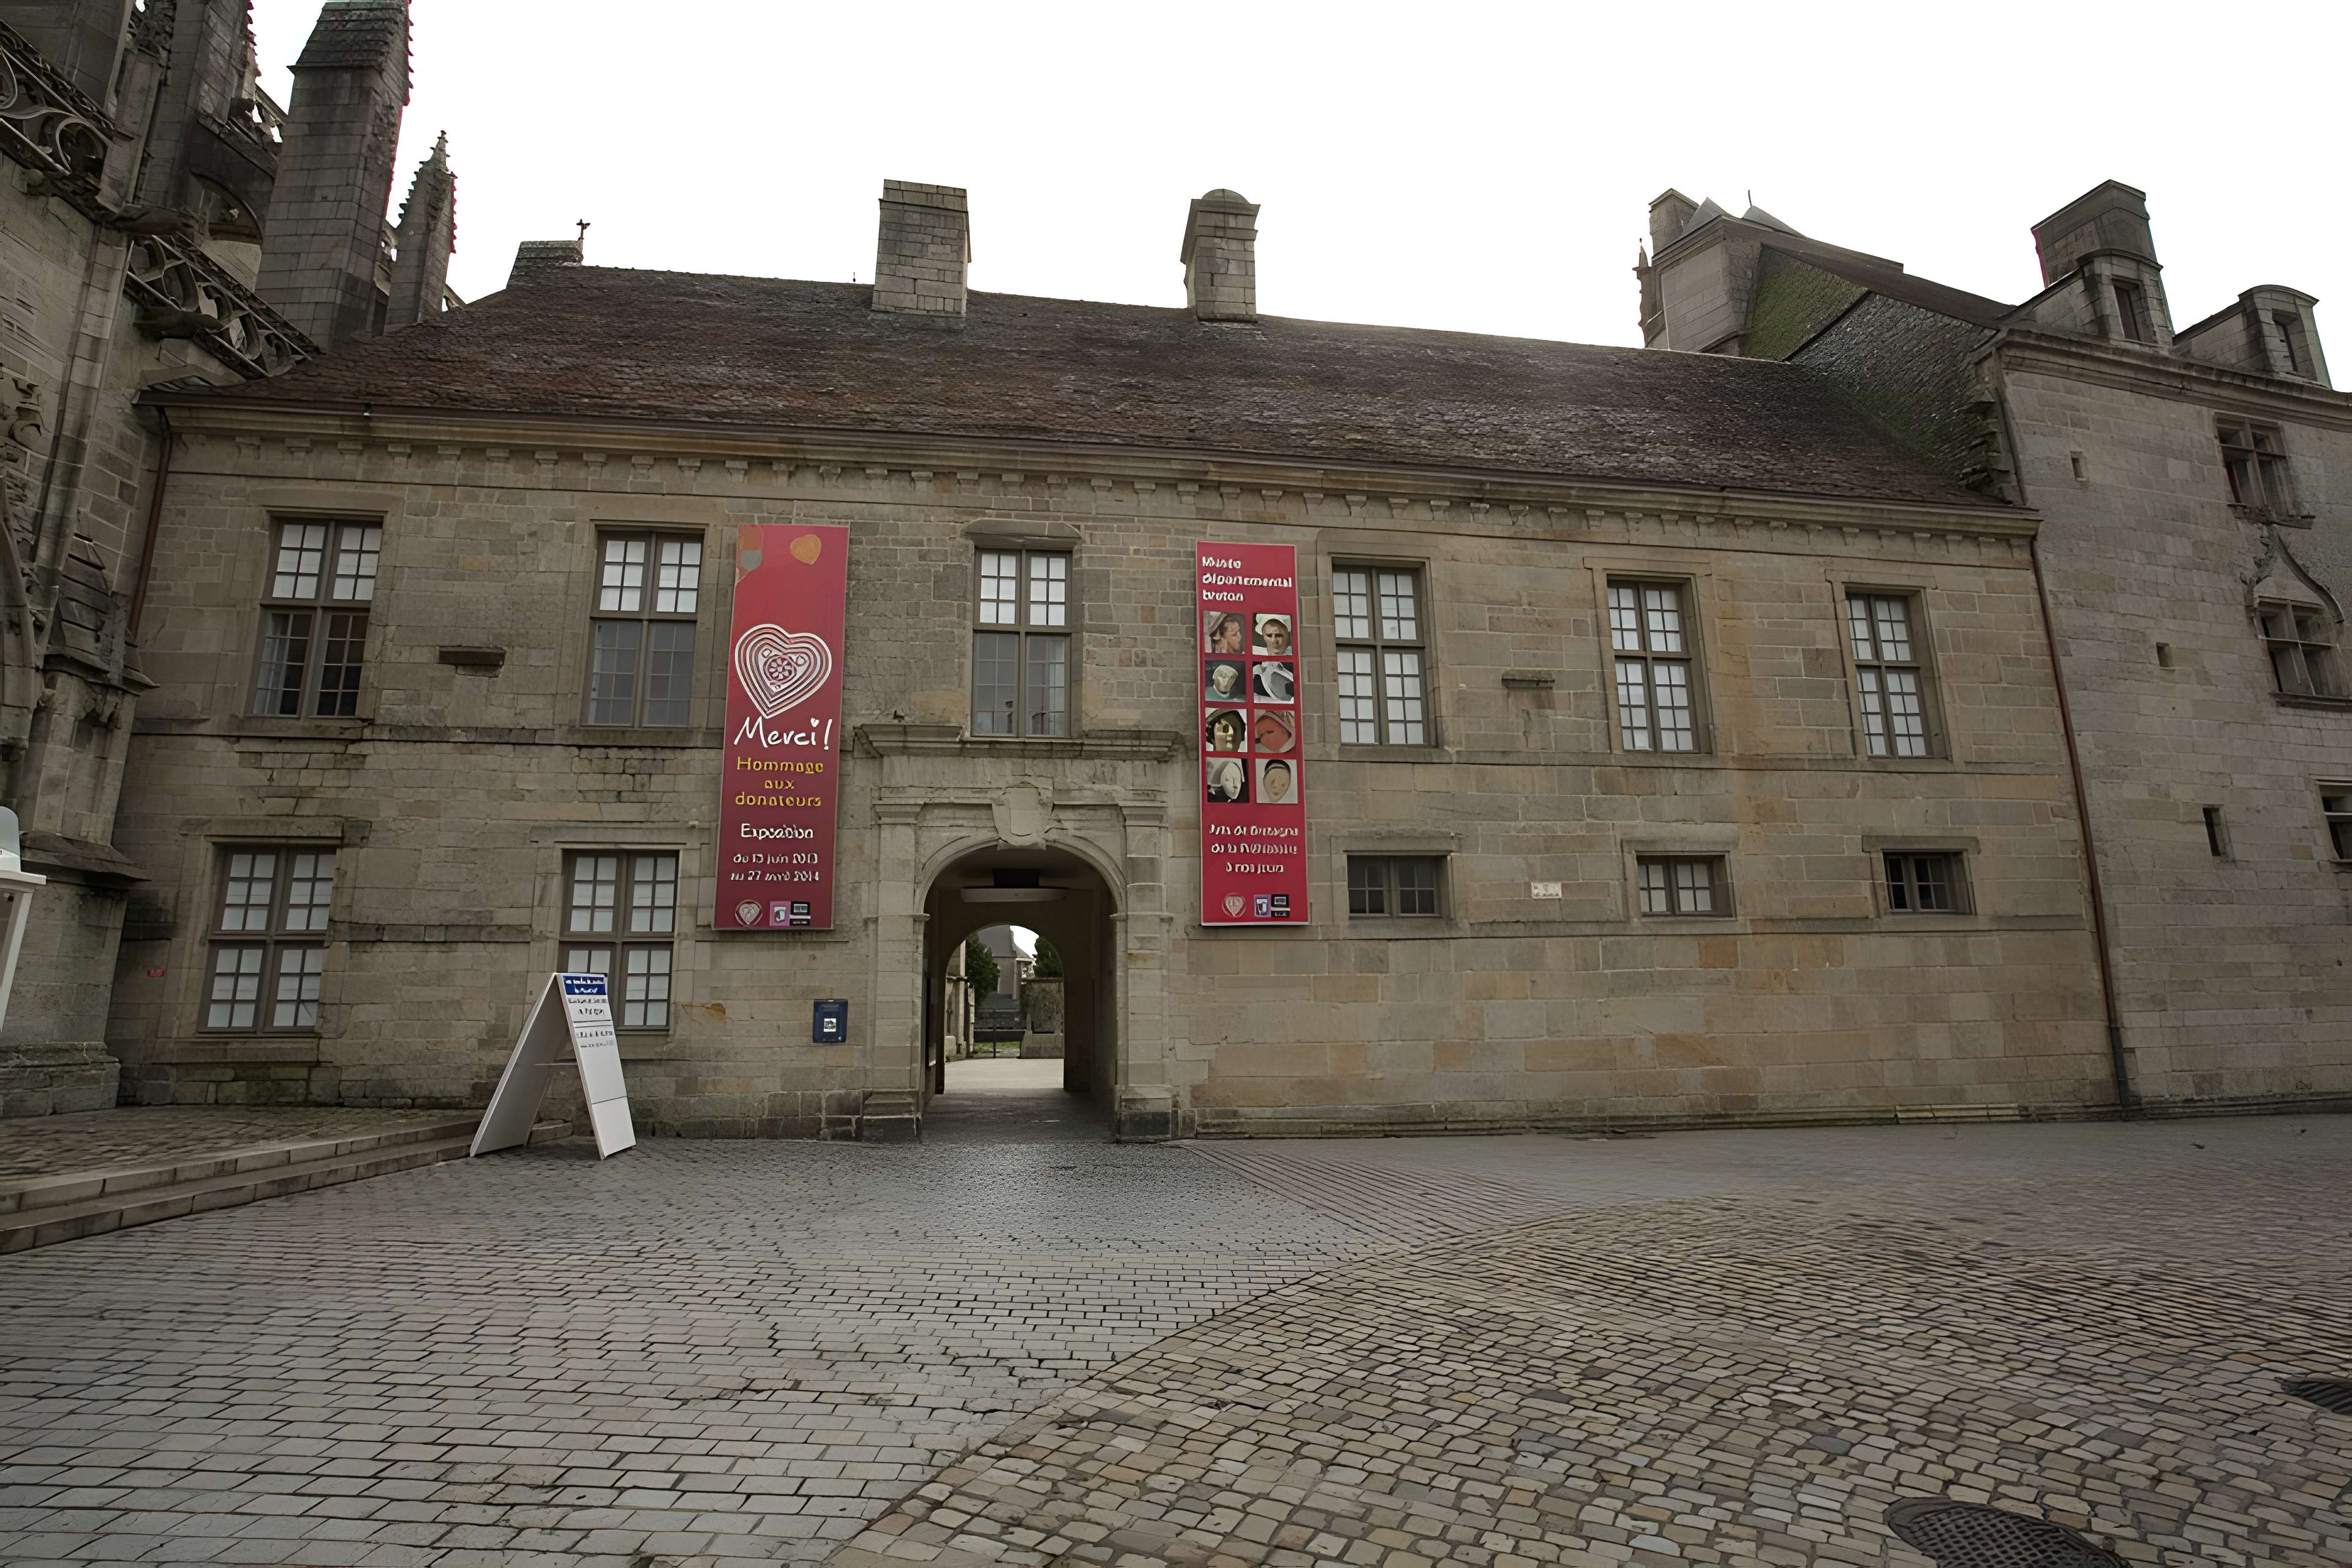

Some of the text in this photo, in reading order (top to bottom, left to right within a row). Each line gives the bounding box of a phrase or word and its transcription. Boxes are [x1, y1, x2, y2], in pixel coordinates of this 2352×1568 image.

[737, 756, 823, 774] Hommage
[764, 780, 794, 789] aux
[735, 792, 821, 807] donateurs
